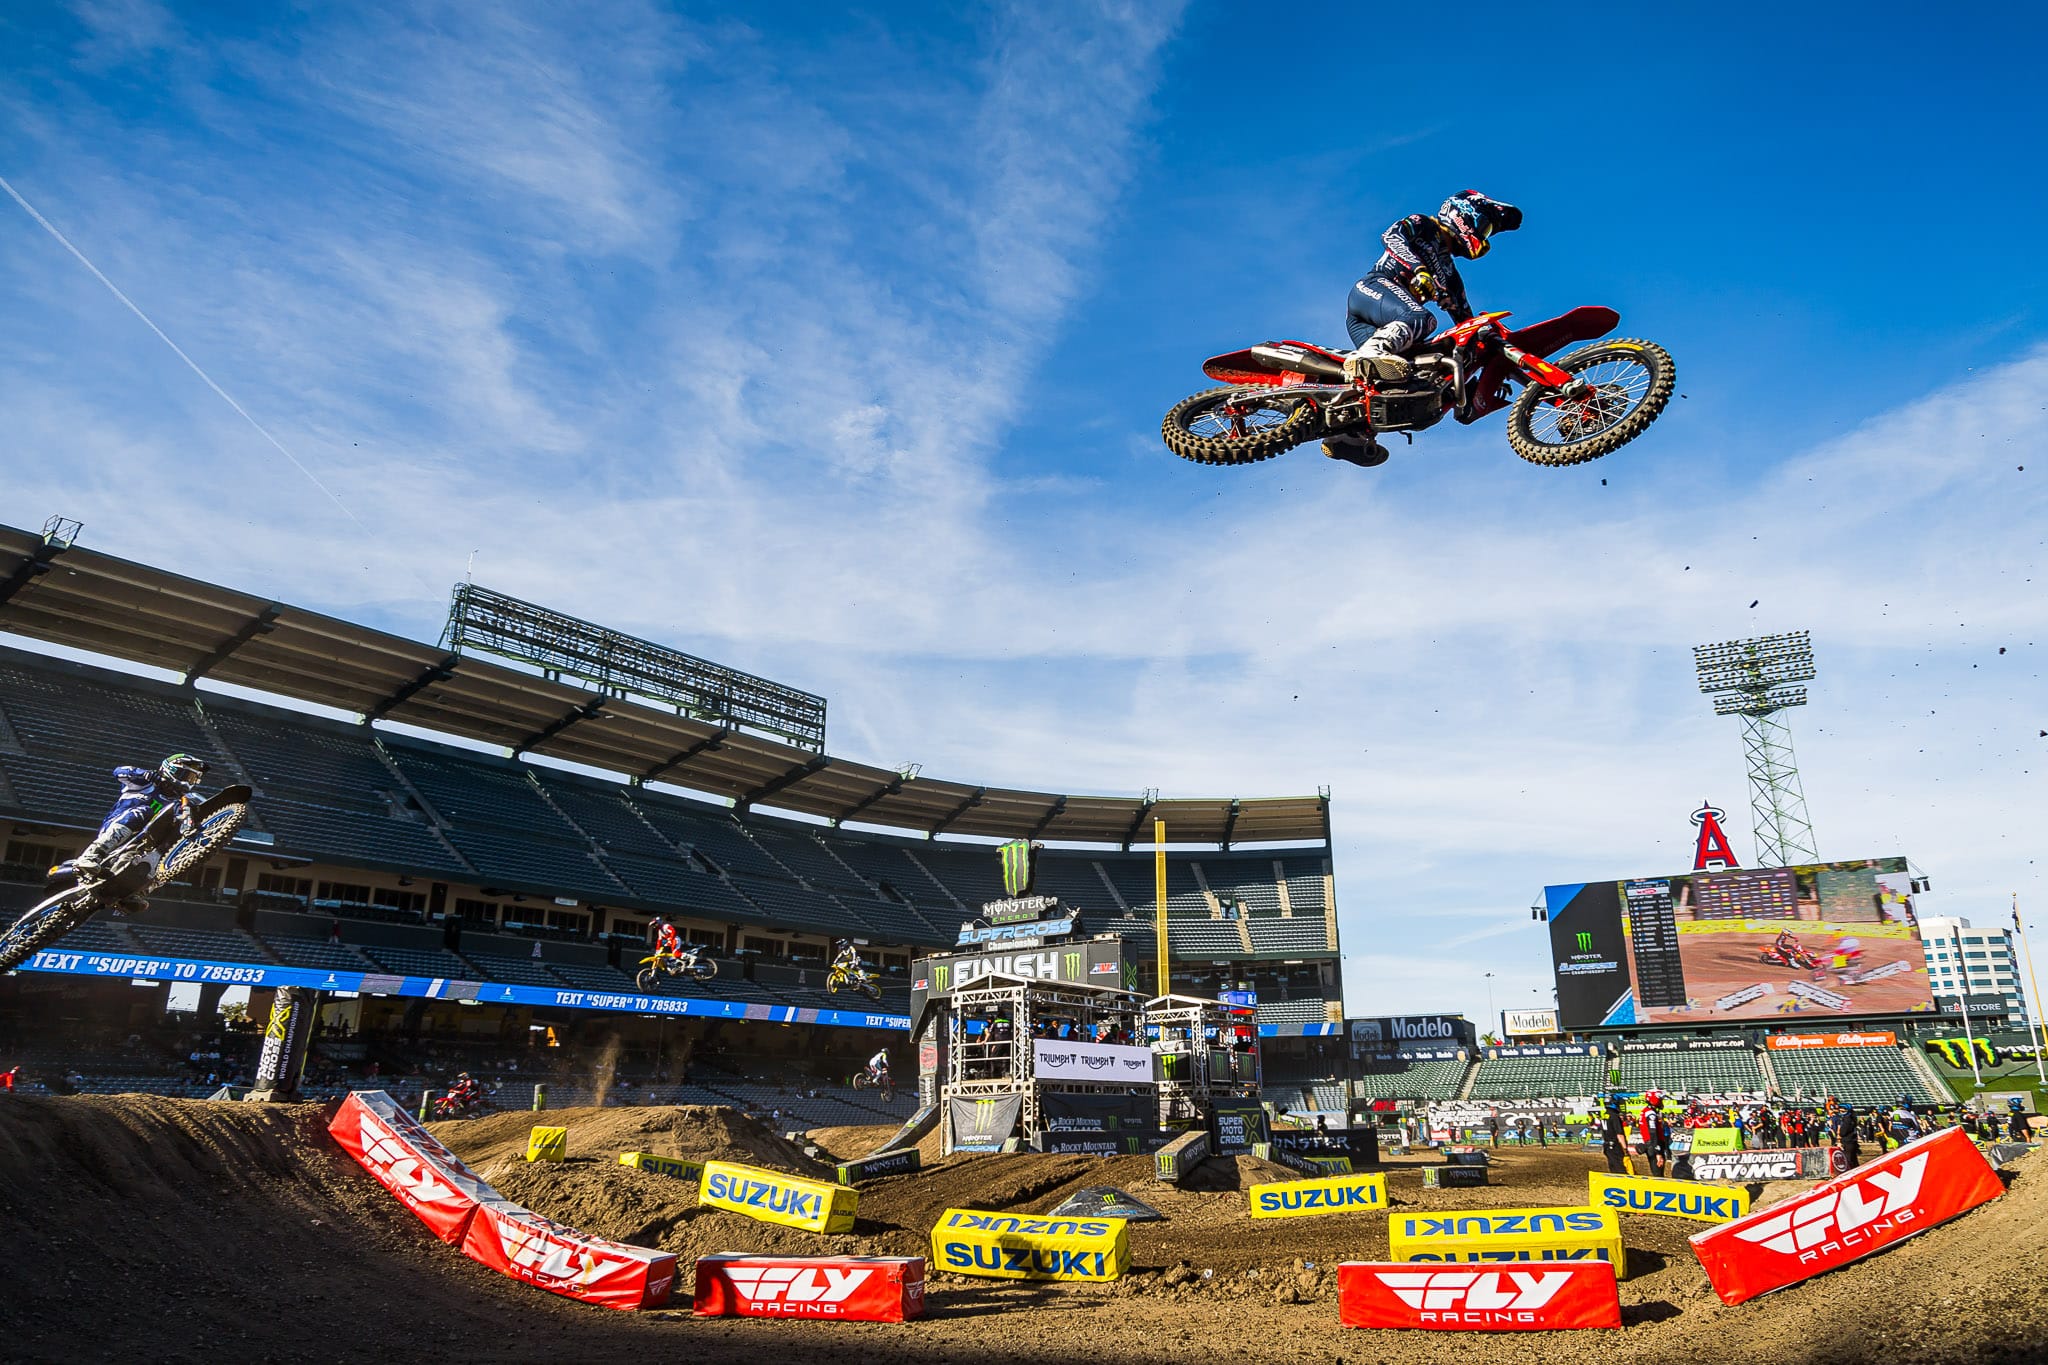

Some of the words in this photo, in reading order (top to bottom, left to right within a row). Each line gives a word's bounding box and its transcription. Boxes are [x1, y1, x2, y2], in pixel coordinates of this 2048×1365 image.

[982, 896, 1046, 917] MONSTER
[992, 913, 1036, 923] ENERGY
[958, 919, 1073, 944] SUPERCROSS
[988, 937, 1040, 951] Championship
[32, 952, 82, 970] TEXT
[88, 957, 169, 977] "SUPER"
[174, 963, 196, 978] TO
[201, 965, 265, 983] 785833
[954, 951, 1059, 984] FINISH
[556, 991, 583, 1005] TEXT
[587, 994, 633, 1009] "SUPER"
[635, 998, 648, 1010] TO
[651, 1000, 688, 1013] 785833
[1970, 1003, 2001, 1012] STORE
[865, 1015, 884, 1026] TEXT
[1391, 1016, 1453, 1039] Modelo
[1512, 1014, 1551, 1029] Modelo
[1040, 1053, 1070, 1066] TRIUMPH
[1081, 1055, 1109, 1068] TRIUMPH
[1123, 1060, 1142, 1068] TRIUMPH
[1218, 1116, 1243, 1126] SUPER
[1221, 1126, 1243, 1135] MOTO
[1060, 1142, 1082, 1152] ROCKY
[1083, 1141, 1117, 1152] MOUNTAIN
[1220, 1135, 1245, 1145] CROSS
[1697, 1138, 1730, 1147] Kawasaki
[360, 1111, 456, 1202] FLY
[864, 1155, 909, 1173] MONSTER
[1282, 1152, 1319, 1173] MONSTER
[1707, 1154, 1740, 1165] ROCKY
[1741, 1152, 1796, 1164] MOUNTAIN
[642, 1158, 700, 1182] SUZUK
[708, 1173, 823, 1220] SUZUKI
[1260, 1185, 1378, 1211] SUZUKI
[1604, 1187, 1740, 1219] SUZUKI
[1733, 1151, 1931, 1255] FLY
[832, 1208, 856, 1217] SUZUKI
[947, 1213, 1110, 1236] SUZUKI
[1405, 1212, 1604, 1237] SUZUKI
[497, 1219, 625, 1285] FLY
[945, 1242, 1106, 1277] SUZUKI
[723, 1267, 875, 1302] FLY
[1374, 1271, 1576, 1310] FLY
